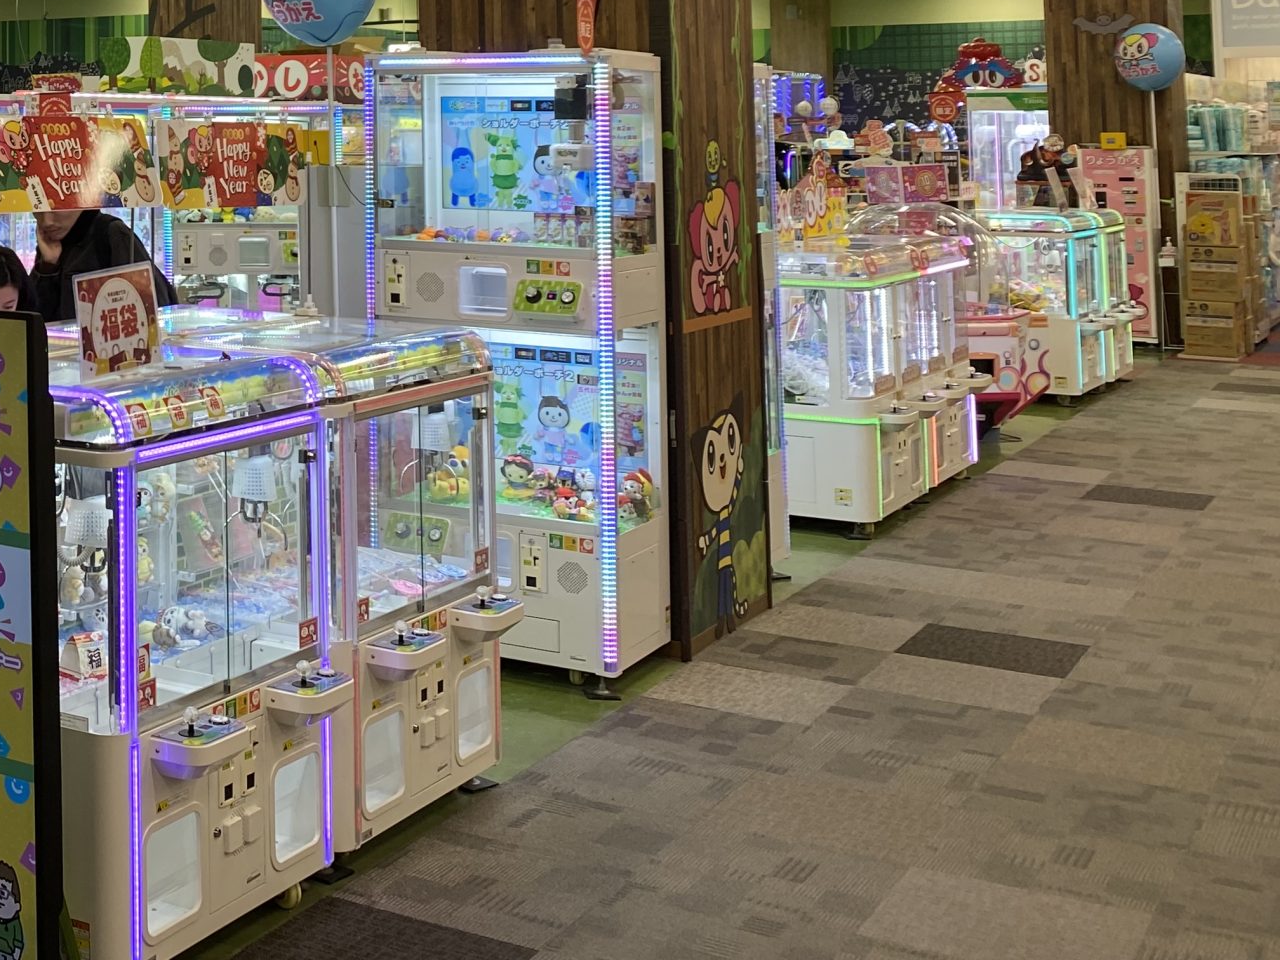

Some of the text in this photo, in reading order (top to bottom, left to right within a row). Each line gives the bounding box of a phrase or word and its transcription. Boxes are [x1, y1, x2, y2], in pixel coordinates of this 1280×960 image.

[33, 133, 84, 160] Happy
[216, 138, 251, 162] Happy
[48, 157, 81, 179] New
[223, 160, 247, 179] New
[1086, 154, 1141, 167] りょうがえ
[47, 177, 86, 200] Year
[220, 178, 249, 198] Year
[100, 303, 140, 342] 福袋
[494, 365, 575, 382] ョルダーポーチ2
[86, 647, 102, 669] 福
